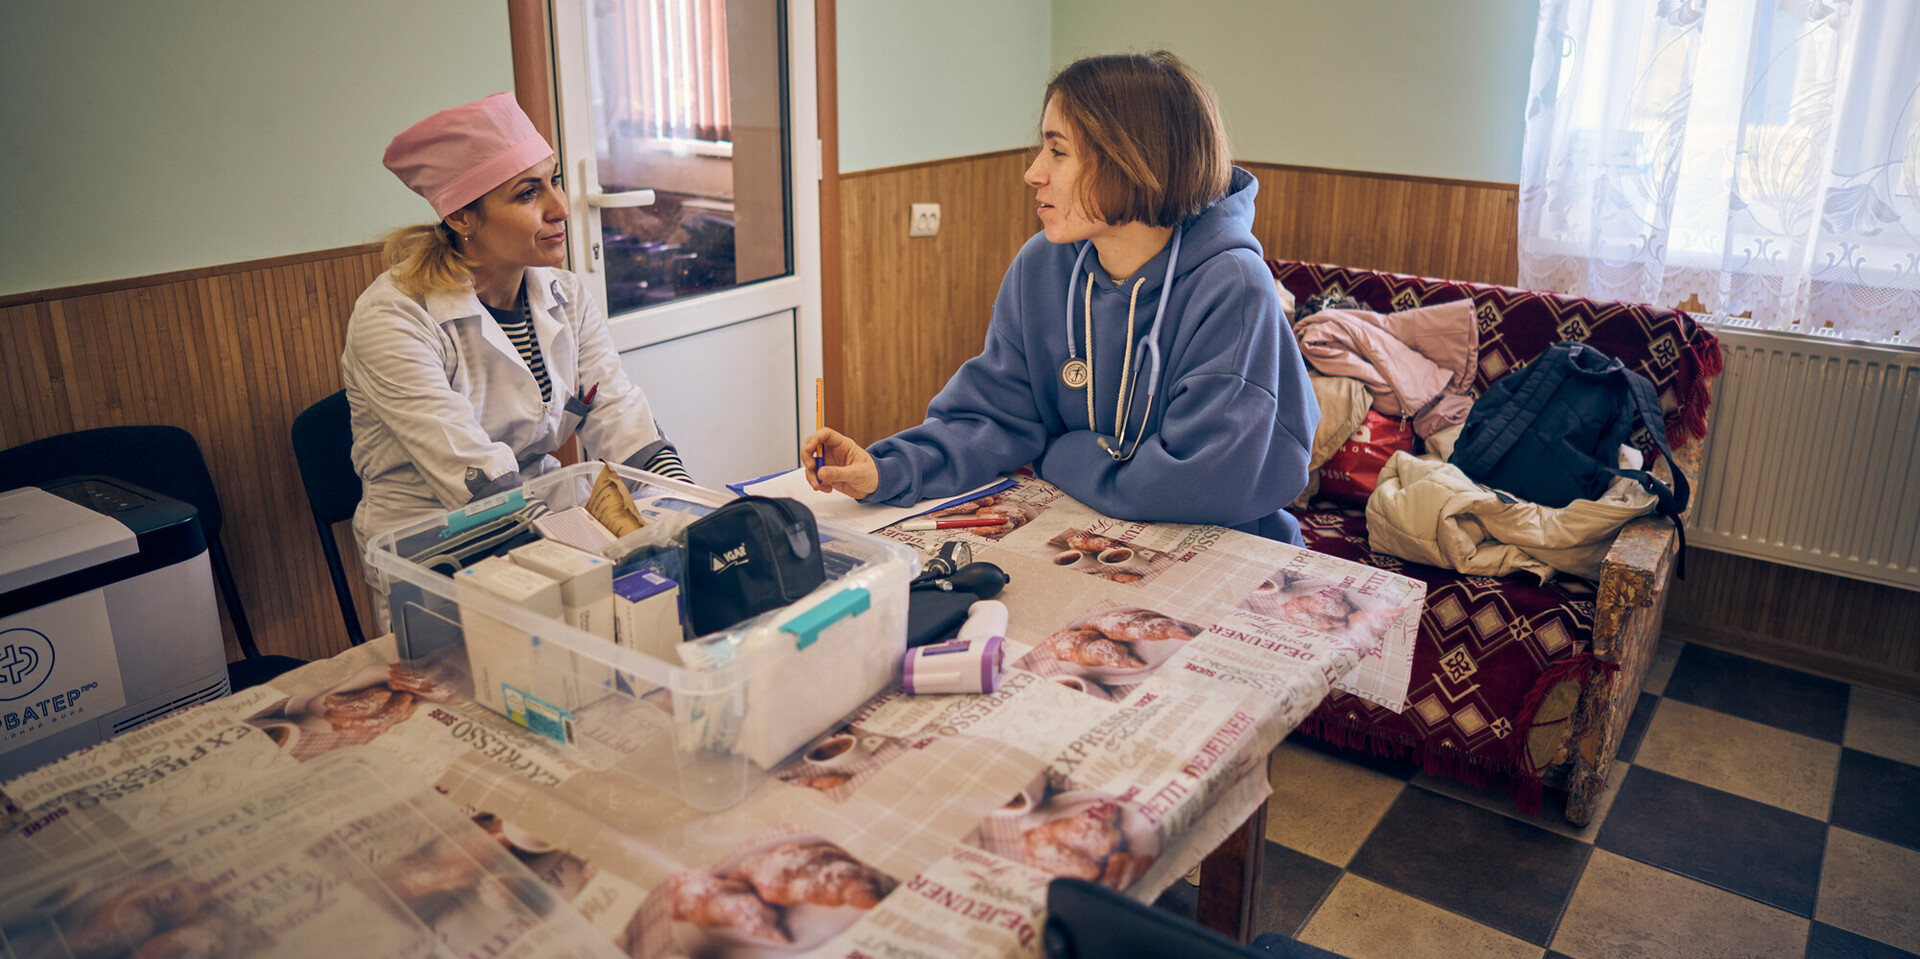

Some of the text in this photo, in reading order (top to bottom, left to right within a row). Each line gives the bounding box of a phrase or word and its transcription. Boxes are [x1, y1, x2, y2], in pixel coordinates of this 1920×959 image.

[723, 546, 746, 562] IGAR
[1357, 570, 1390, 597] PETIT
[1183, 663, 1217, 677] SUCRE
[0, 681, 98, 731] ВАТЕР ПРО
[51, 707, 84, 723] ФОНД
[938, 675, 1035, 734] EXPRESSO
[173, 718, 232, 750] PAIN
[1042, 711, 1138, 777] EXPRESSO
[75, 722, 253, 816] EXPRESSO
[451, 720, 562, 788] EXPRESSO
[1138, 779, 1188, 822] PETIT
[19, 809, 70, 839] SUCRE
